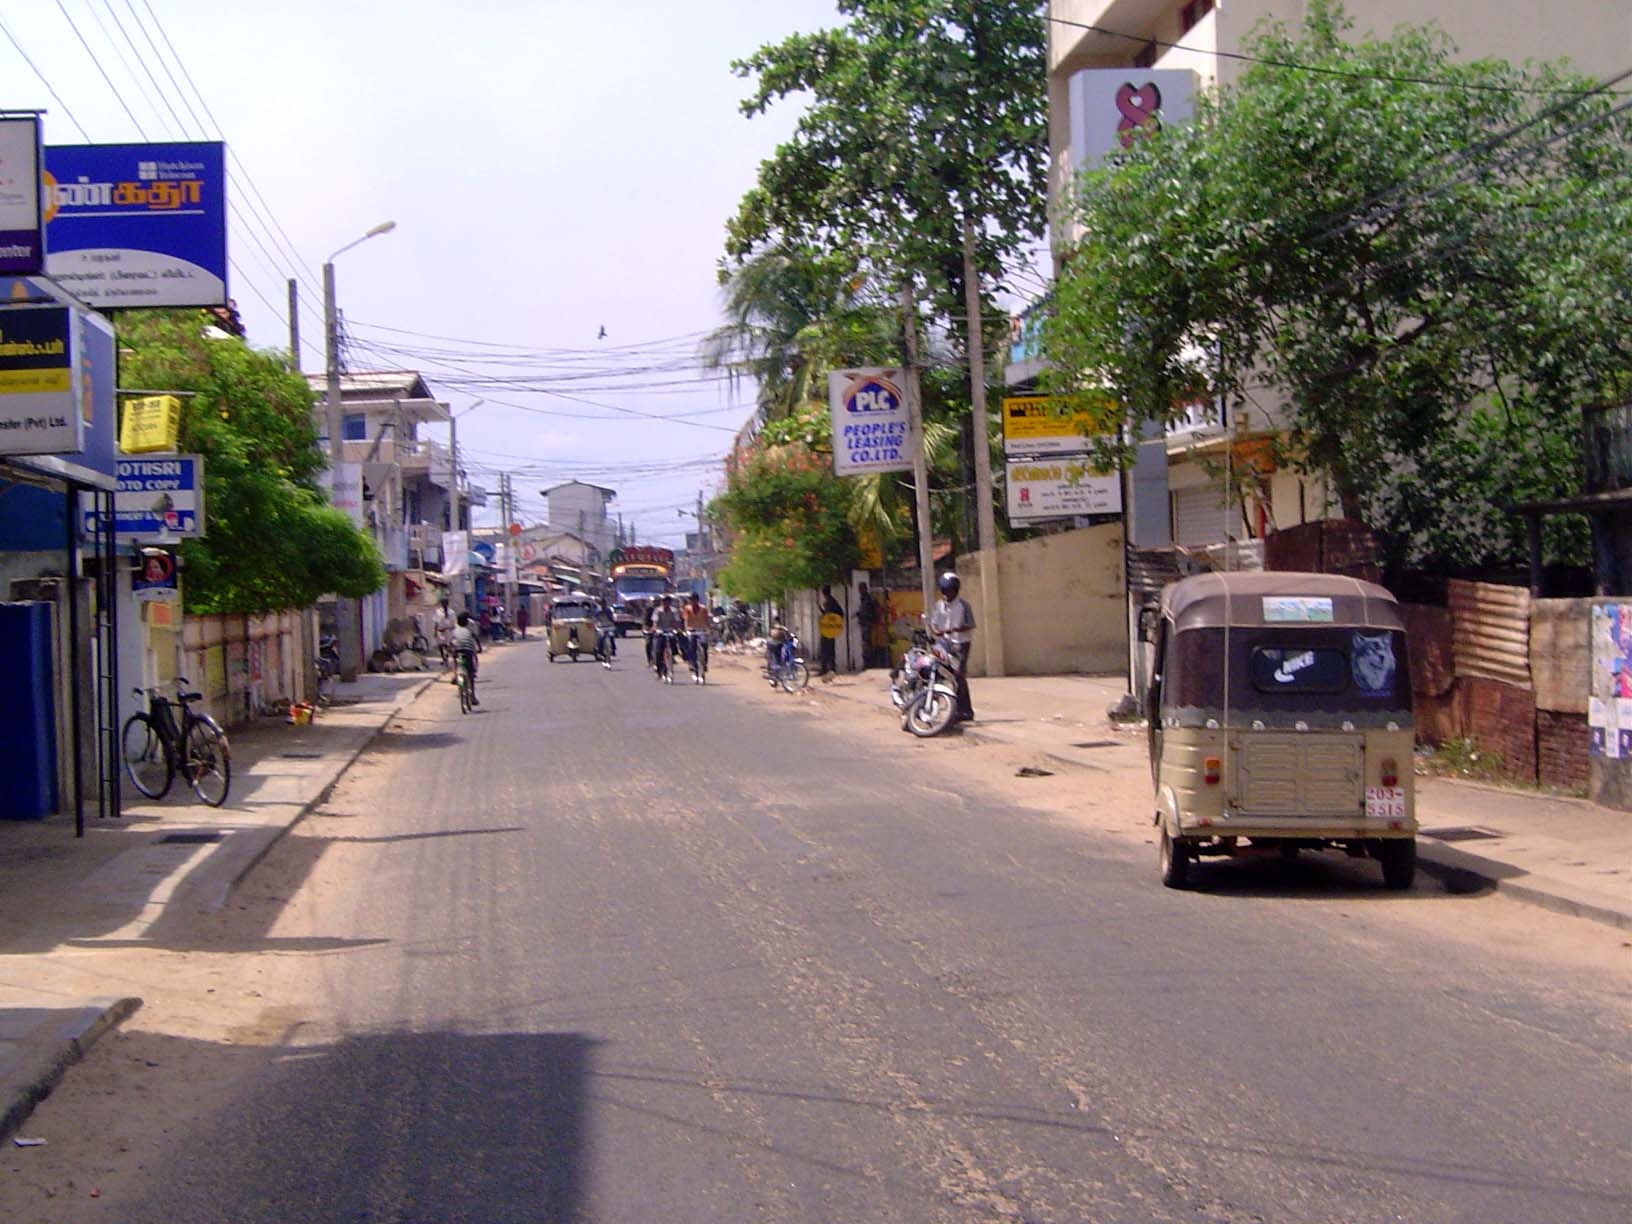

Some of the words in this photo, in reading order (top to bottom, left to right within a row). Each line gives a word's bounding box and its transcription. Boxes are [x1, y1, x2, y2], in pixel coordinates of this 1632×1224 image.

[855, 391, 890, 411] PLC
[844, 421, 906, 437] PEOPLE'S
[847, 434, 903, 449] LEASING
[145, 479, 181, 490] COPY
